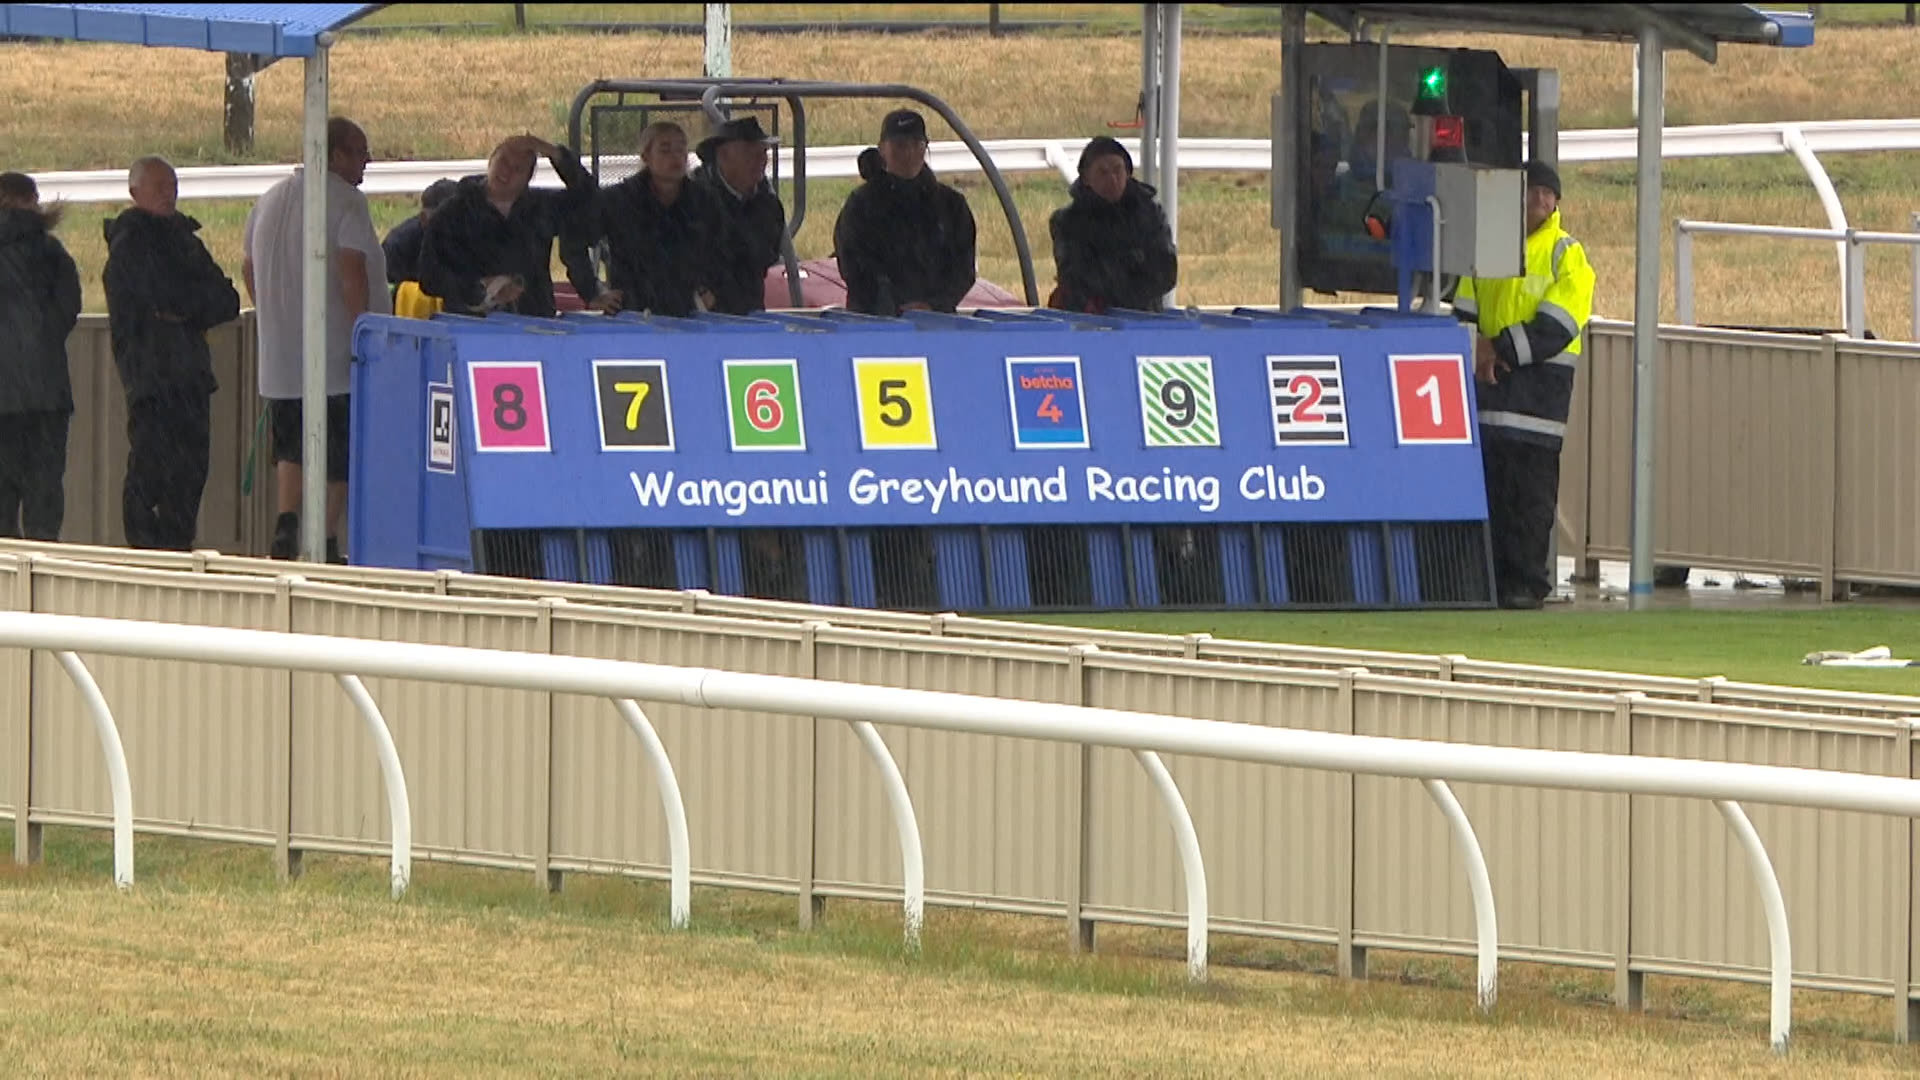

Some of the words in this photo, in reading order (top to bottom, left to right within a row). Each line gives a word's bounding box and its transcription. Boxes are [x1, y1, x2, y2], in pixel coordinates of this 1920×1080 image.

[613, 381, 650, 430] 7
[744, 378, 784, 432] 6
[879, 380, 912, 427] 5
[1020, 375, 1074, 389] betcha
[1160, 379, 1197, 428] 9
[1289, 375, 1325, 422] 2
[1415, 374, 1442, 426] 1
[493, 384, 528, 431] 8
[1036, 393, 1063, 423] 4
[630, 470, 828, 516] Wanganui
[849, 466, 1067, 513] Greyhound
[1087, 467, 1219, 511] Racing
[1240, 465, 1325, 500] Club
